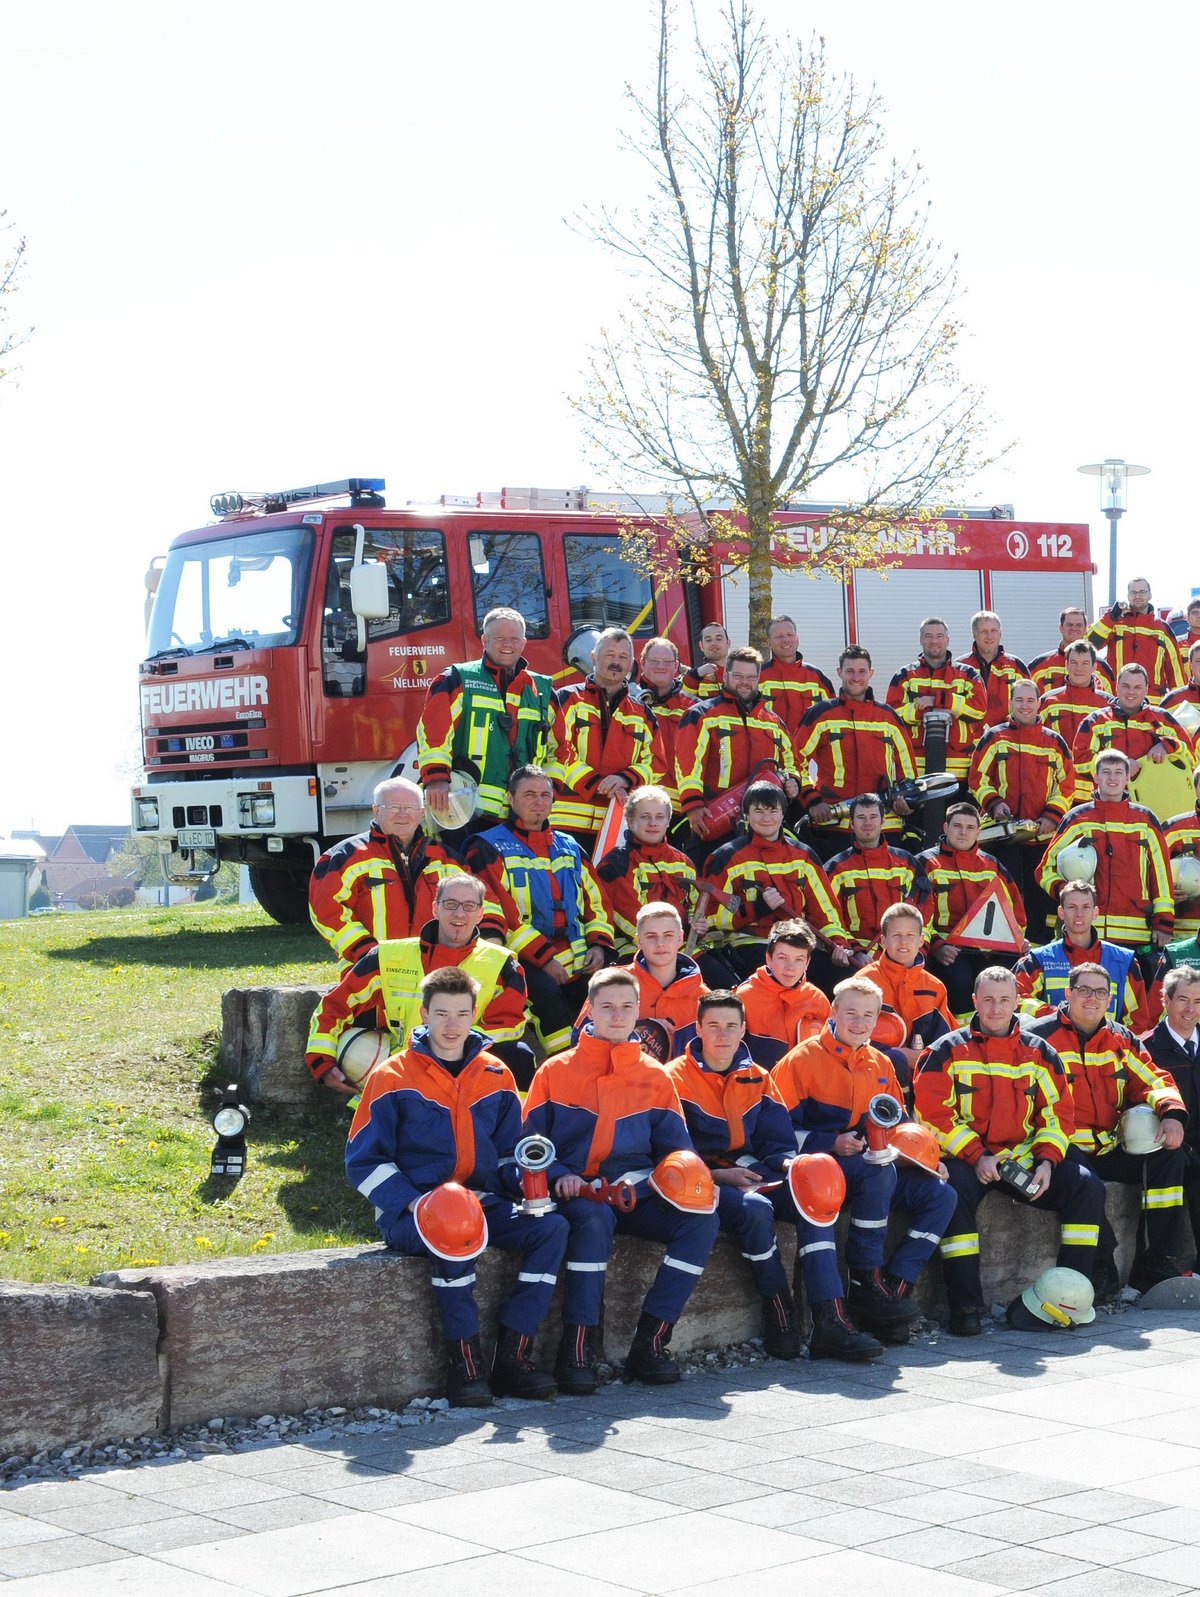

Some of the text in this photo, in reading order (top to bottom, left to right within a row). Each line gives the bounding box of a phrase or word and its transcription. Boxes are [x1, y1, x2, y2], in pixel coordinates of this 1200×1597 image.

[1037, 534, 1073, 557] 112
[388, 645, 446, 657] FEUERWEHR
[393, 677, 433, 689] NELLING
[140, 675, 269, 715] FEUERWEHR
[185, 735, 215, 751] IVECO
[189, 753, 215, 763] MAGIRUS
[192, 832, 203, 845] EC
[204, 832, 214, 845] 112
[641, 1029, 664, 1057] STAHL
